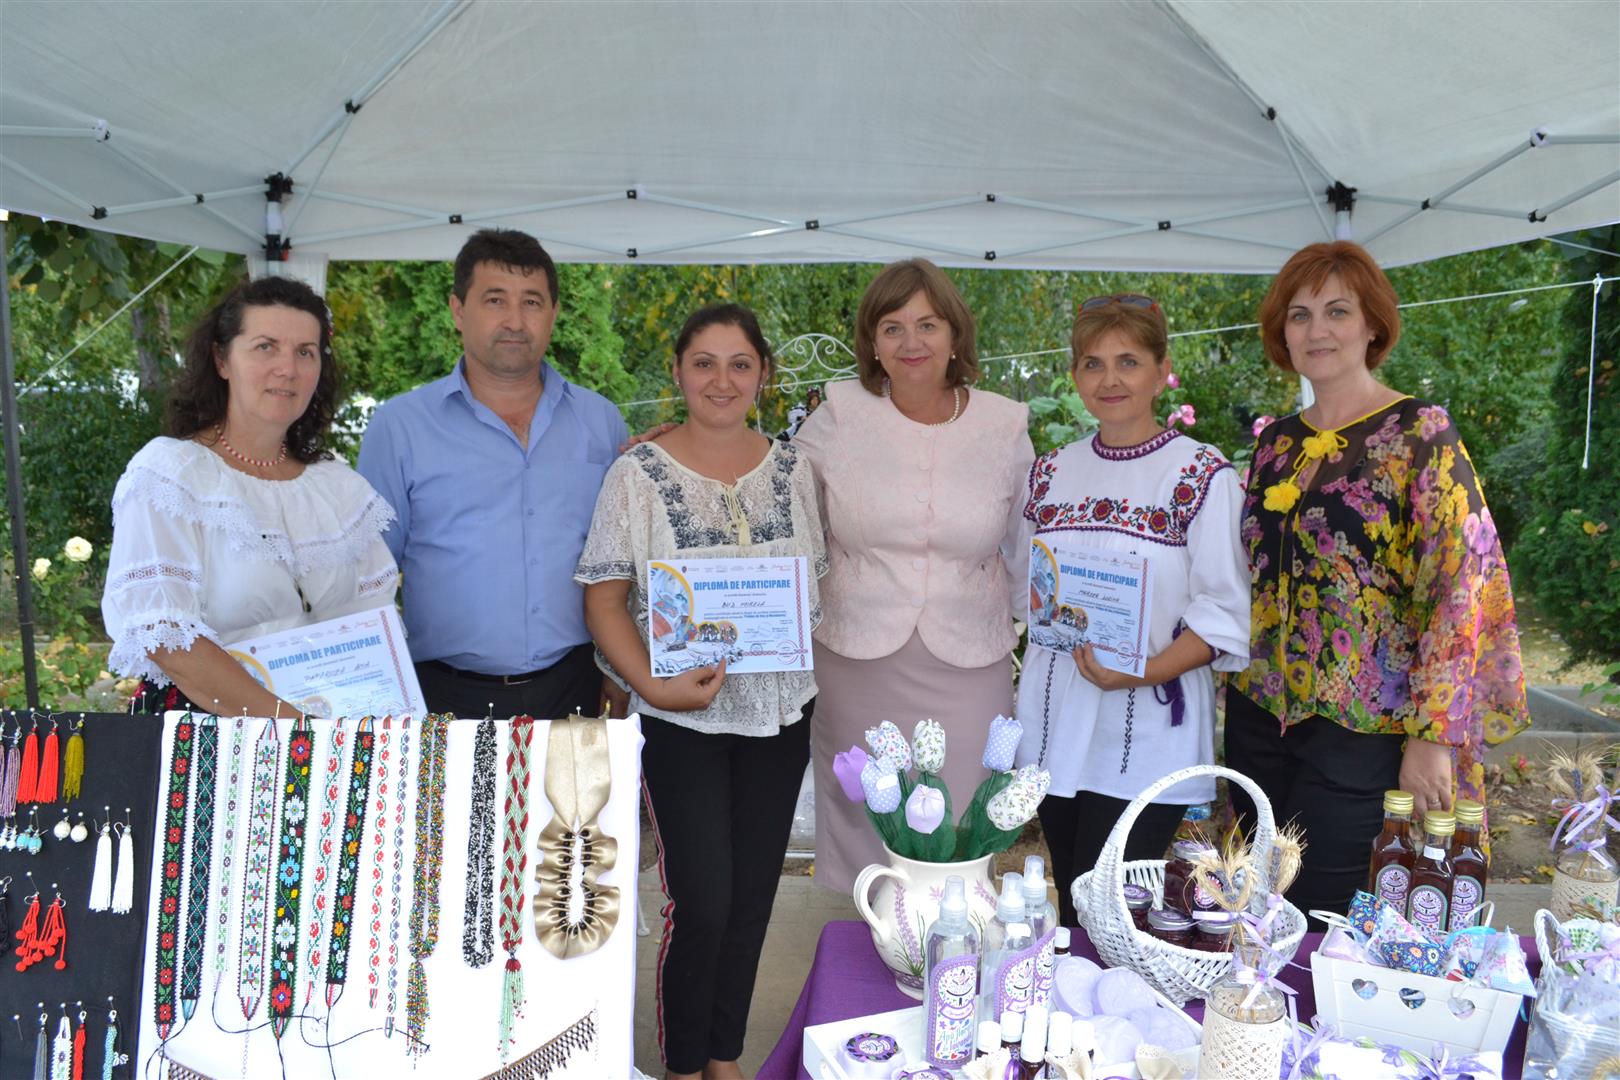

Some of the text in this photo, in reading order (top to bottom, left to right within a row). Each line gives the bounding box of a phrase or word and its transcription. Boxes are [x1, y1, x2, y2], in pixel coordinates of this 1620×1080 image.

[730, 580, 740, 590] DE
[741, 579, 791, 590] PARTICIPARE
[1087, 569, 1096, 580] DE
[1096, 571, 1138, 588] PARTICIPARE
[310, 648, 323, 660] DE
[324, 635, 382, 656] PARTICIPARE
